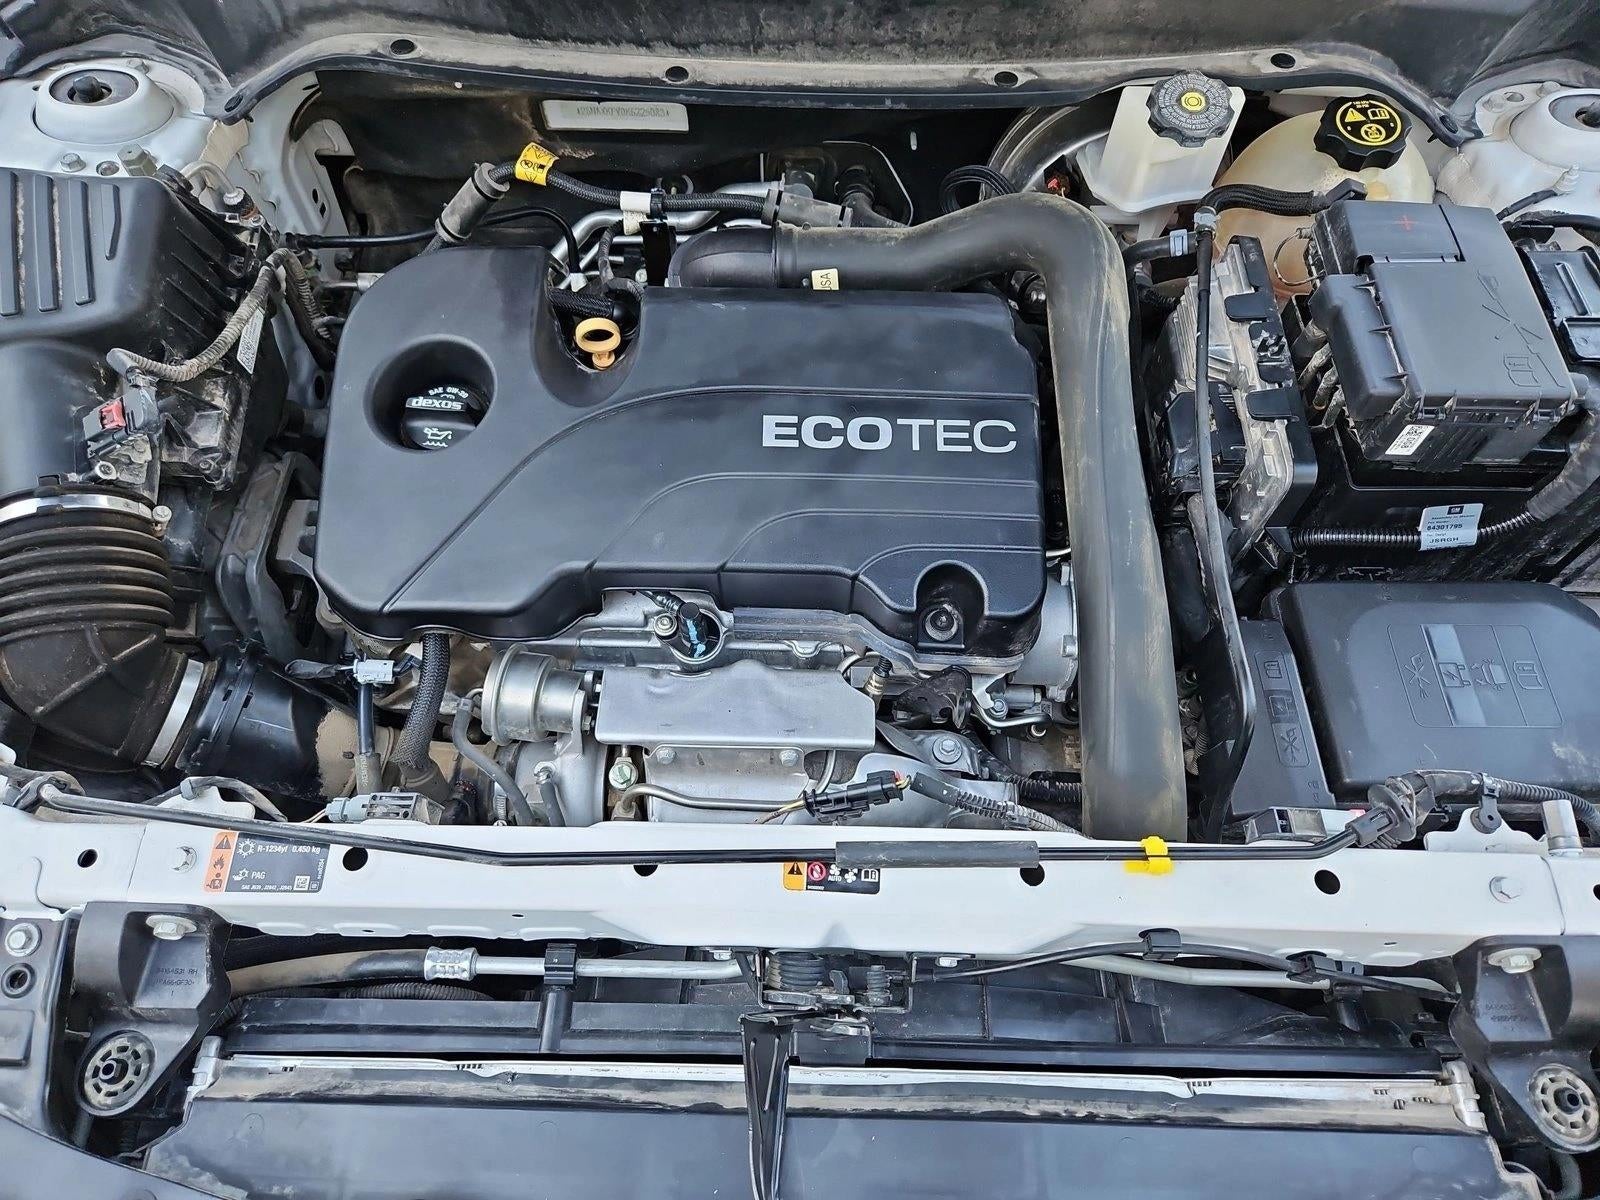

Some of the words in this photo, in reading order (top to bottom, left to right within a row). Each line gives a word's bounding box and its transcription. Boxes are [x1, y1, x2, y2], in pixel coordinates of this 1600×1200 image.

[428, 386, 444, 396] SAE
[446, 386, 469, 399] 0W-20
[411, 396, 463, 410] dexos
[762, 415, 1017, 453] ECOTEC
[1426, 523, 1463, 531] 84301795
[311, 846, 320, 854] kg
[251, 871, 266, 879] PAG
